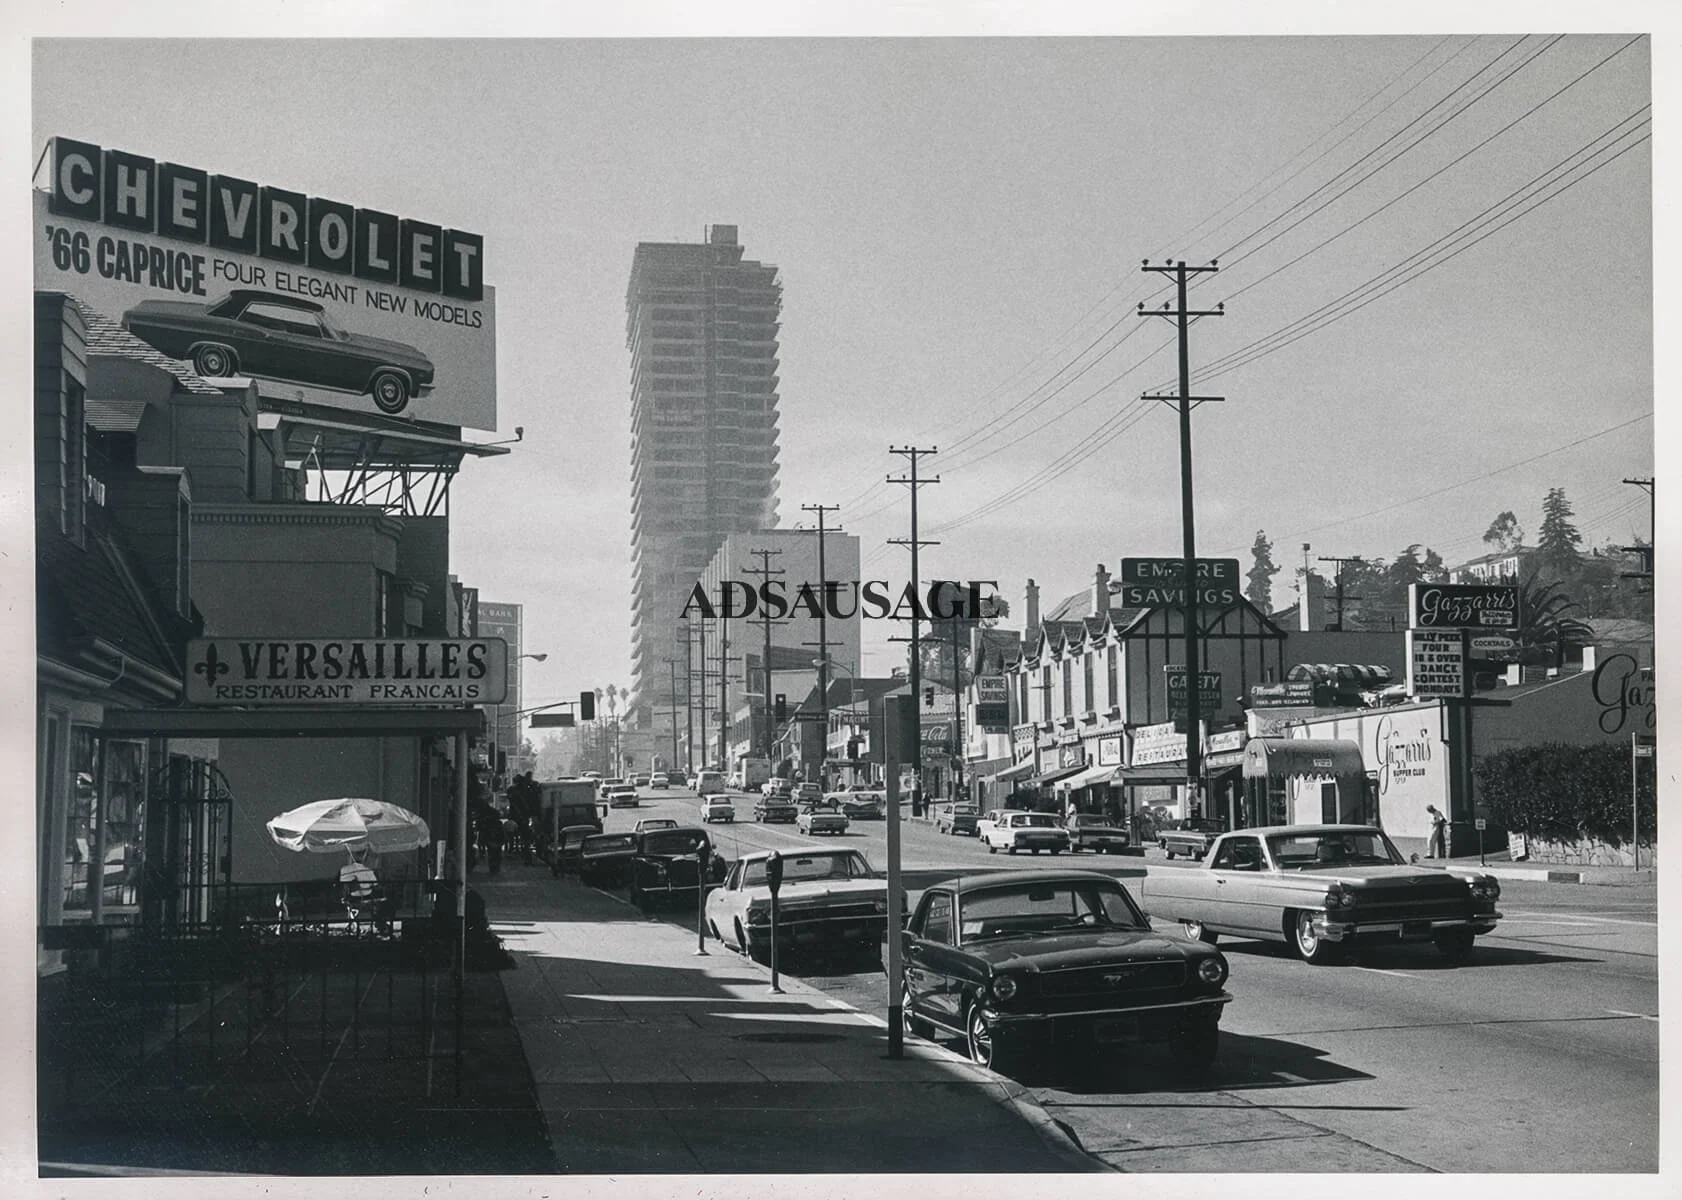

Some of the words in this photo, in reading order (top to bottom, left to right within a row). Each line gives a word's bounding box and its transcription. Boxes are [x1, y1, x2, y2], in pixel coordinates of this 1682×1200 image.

[59, 152, 478, 289] CHEVROLET
[45, 225, 91, 275] '66
[96, 236, 207, 297] CAPRICE
[213, 258, 266, 288] FOUR
[275, 271, 358, 305] ELEGANT
[366, 289, 408, 314] NEW
[414, 298, 482, 329] MODELS
[1419, 588, 1516, 625] Gazzarri's
[1422, 643, 1450, 652] FOUR
[238, 642, 488, 681] VERSAILLES
[1436, 653, 1461, 662] OVER
[1420, 663, 1458, 673] DANCE
[1413, 674, 1461, 683] CONTEST
[215, 684, 353, 699] RESTAURANT
[1415, 684, 1461, 693] MONDAYS
[928, 726, 948, 741] Cola
[1393, 768, 1412, 777] SUPPER
[1412, 768, 1426, 776] CLUB
